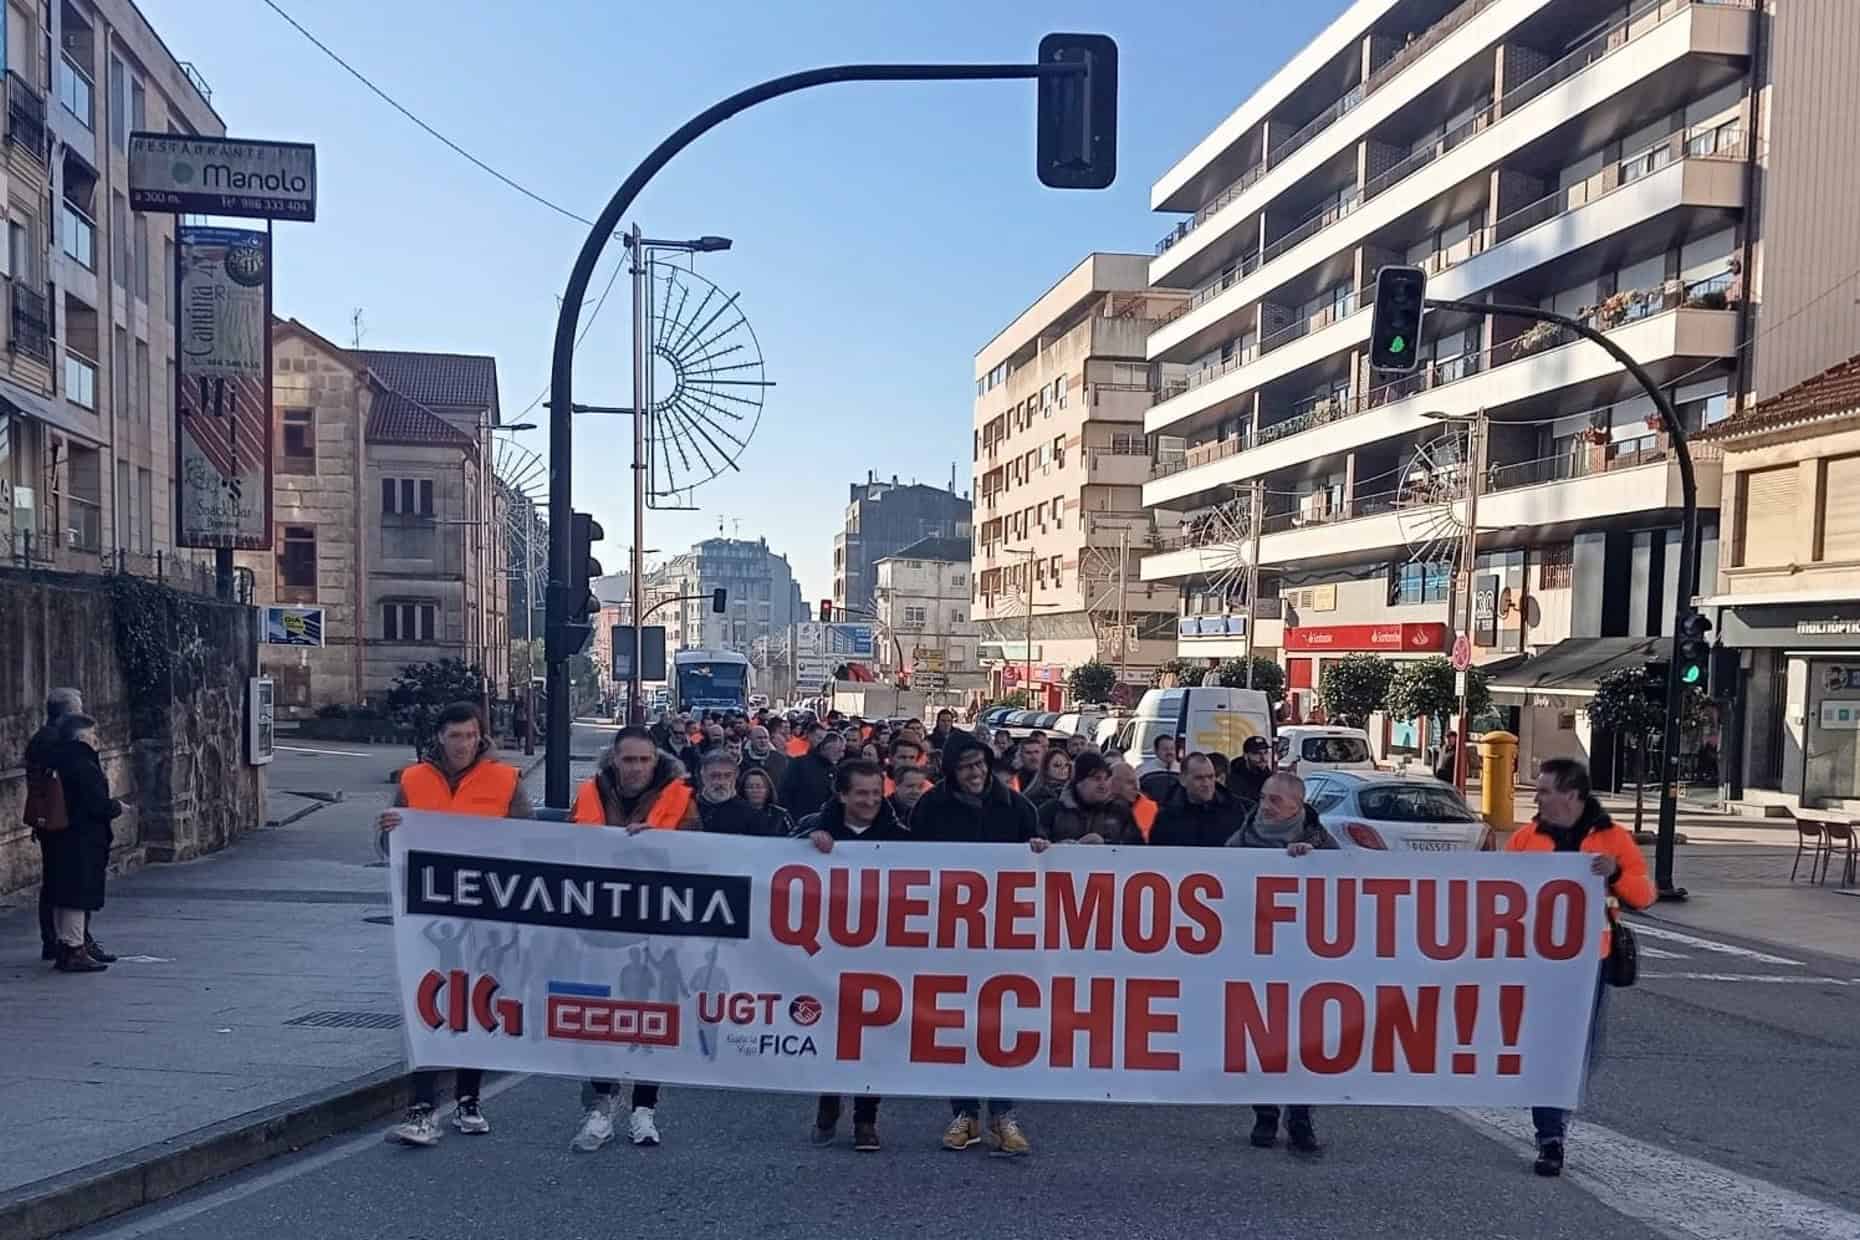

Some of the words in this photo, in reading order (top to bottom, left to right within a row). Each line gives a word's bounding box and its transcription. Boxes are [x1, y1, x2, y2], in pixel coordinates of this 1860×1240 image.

[202, 164, 306, 192] Manolo
[421, 865, 735, 924] LEVANTINA
[768, 864, 1225, 957] QUEREMOS
[1254, 876, 1587, 961] FUTURO
[417, 969, 523, 1036] CIG
[556, 1005, 668, 1036] CCOO
[698, 991, 783, 1025] UGT
[836, 972, 1181, 1071] PECHE
[1223, 980, 1526, 1076] NON!!
[759, 1034, 818, 1056] FICA
